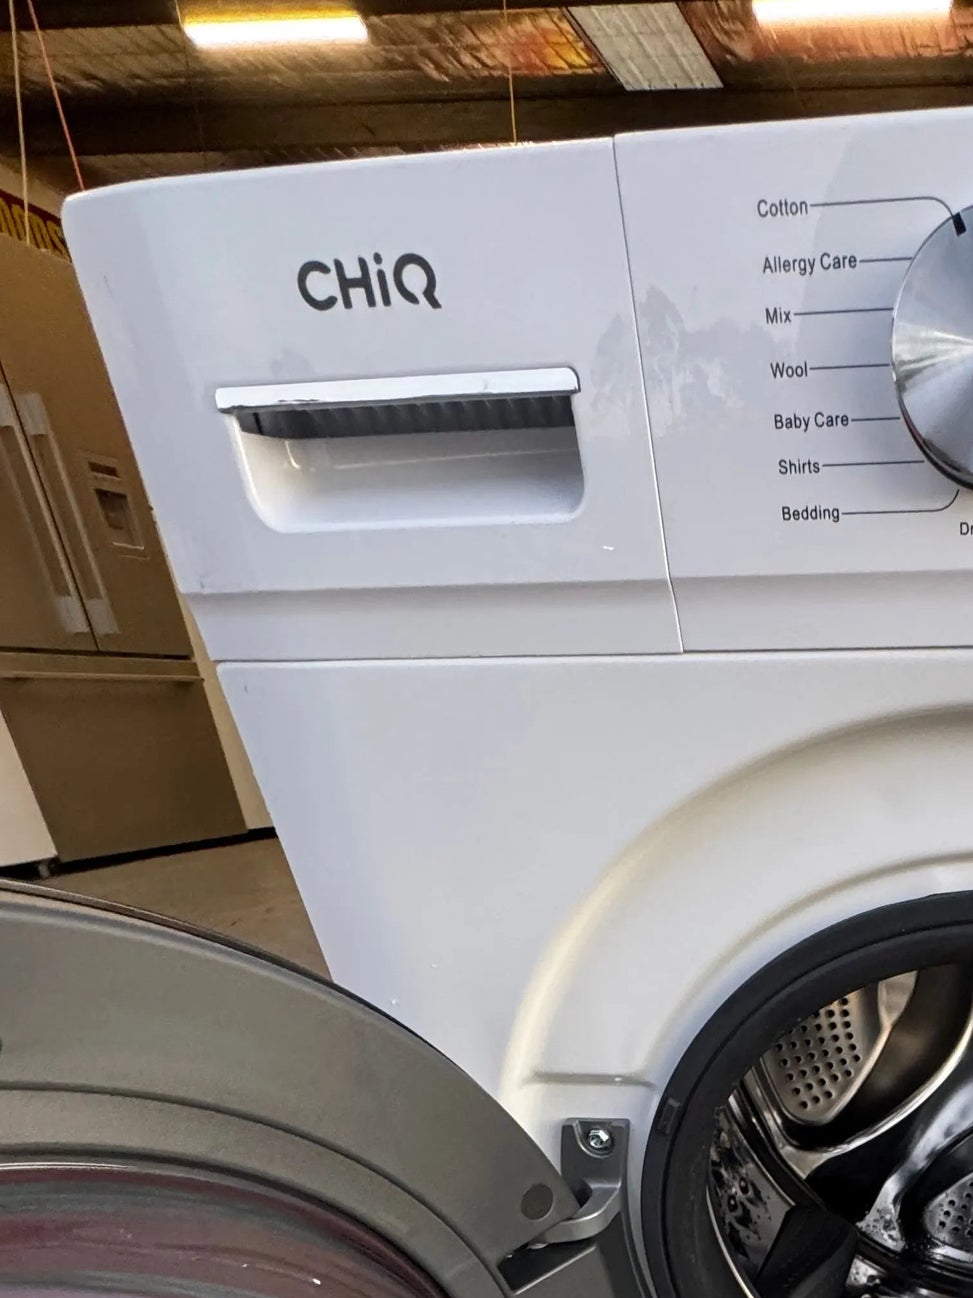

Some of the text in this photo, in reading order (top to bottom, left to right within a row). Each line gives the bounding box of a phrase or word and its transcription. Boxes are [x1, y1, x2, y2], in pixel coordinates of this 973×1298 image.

[757, 198, 808, 217] Cotton
[763, 252, 857, 276] Allergy Care
[297, 252, 442, 311] CHiQ
[765, 307, 792, 324] Mix
[770, 361, 808, 378] Wool
[774, 411, 849, 431] Baby Care
[778, 459, 821, 475] Shirts
[781, 506, 841, 523] Bedding
